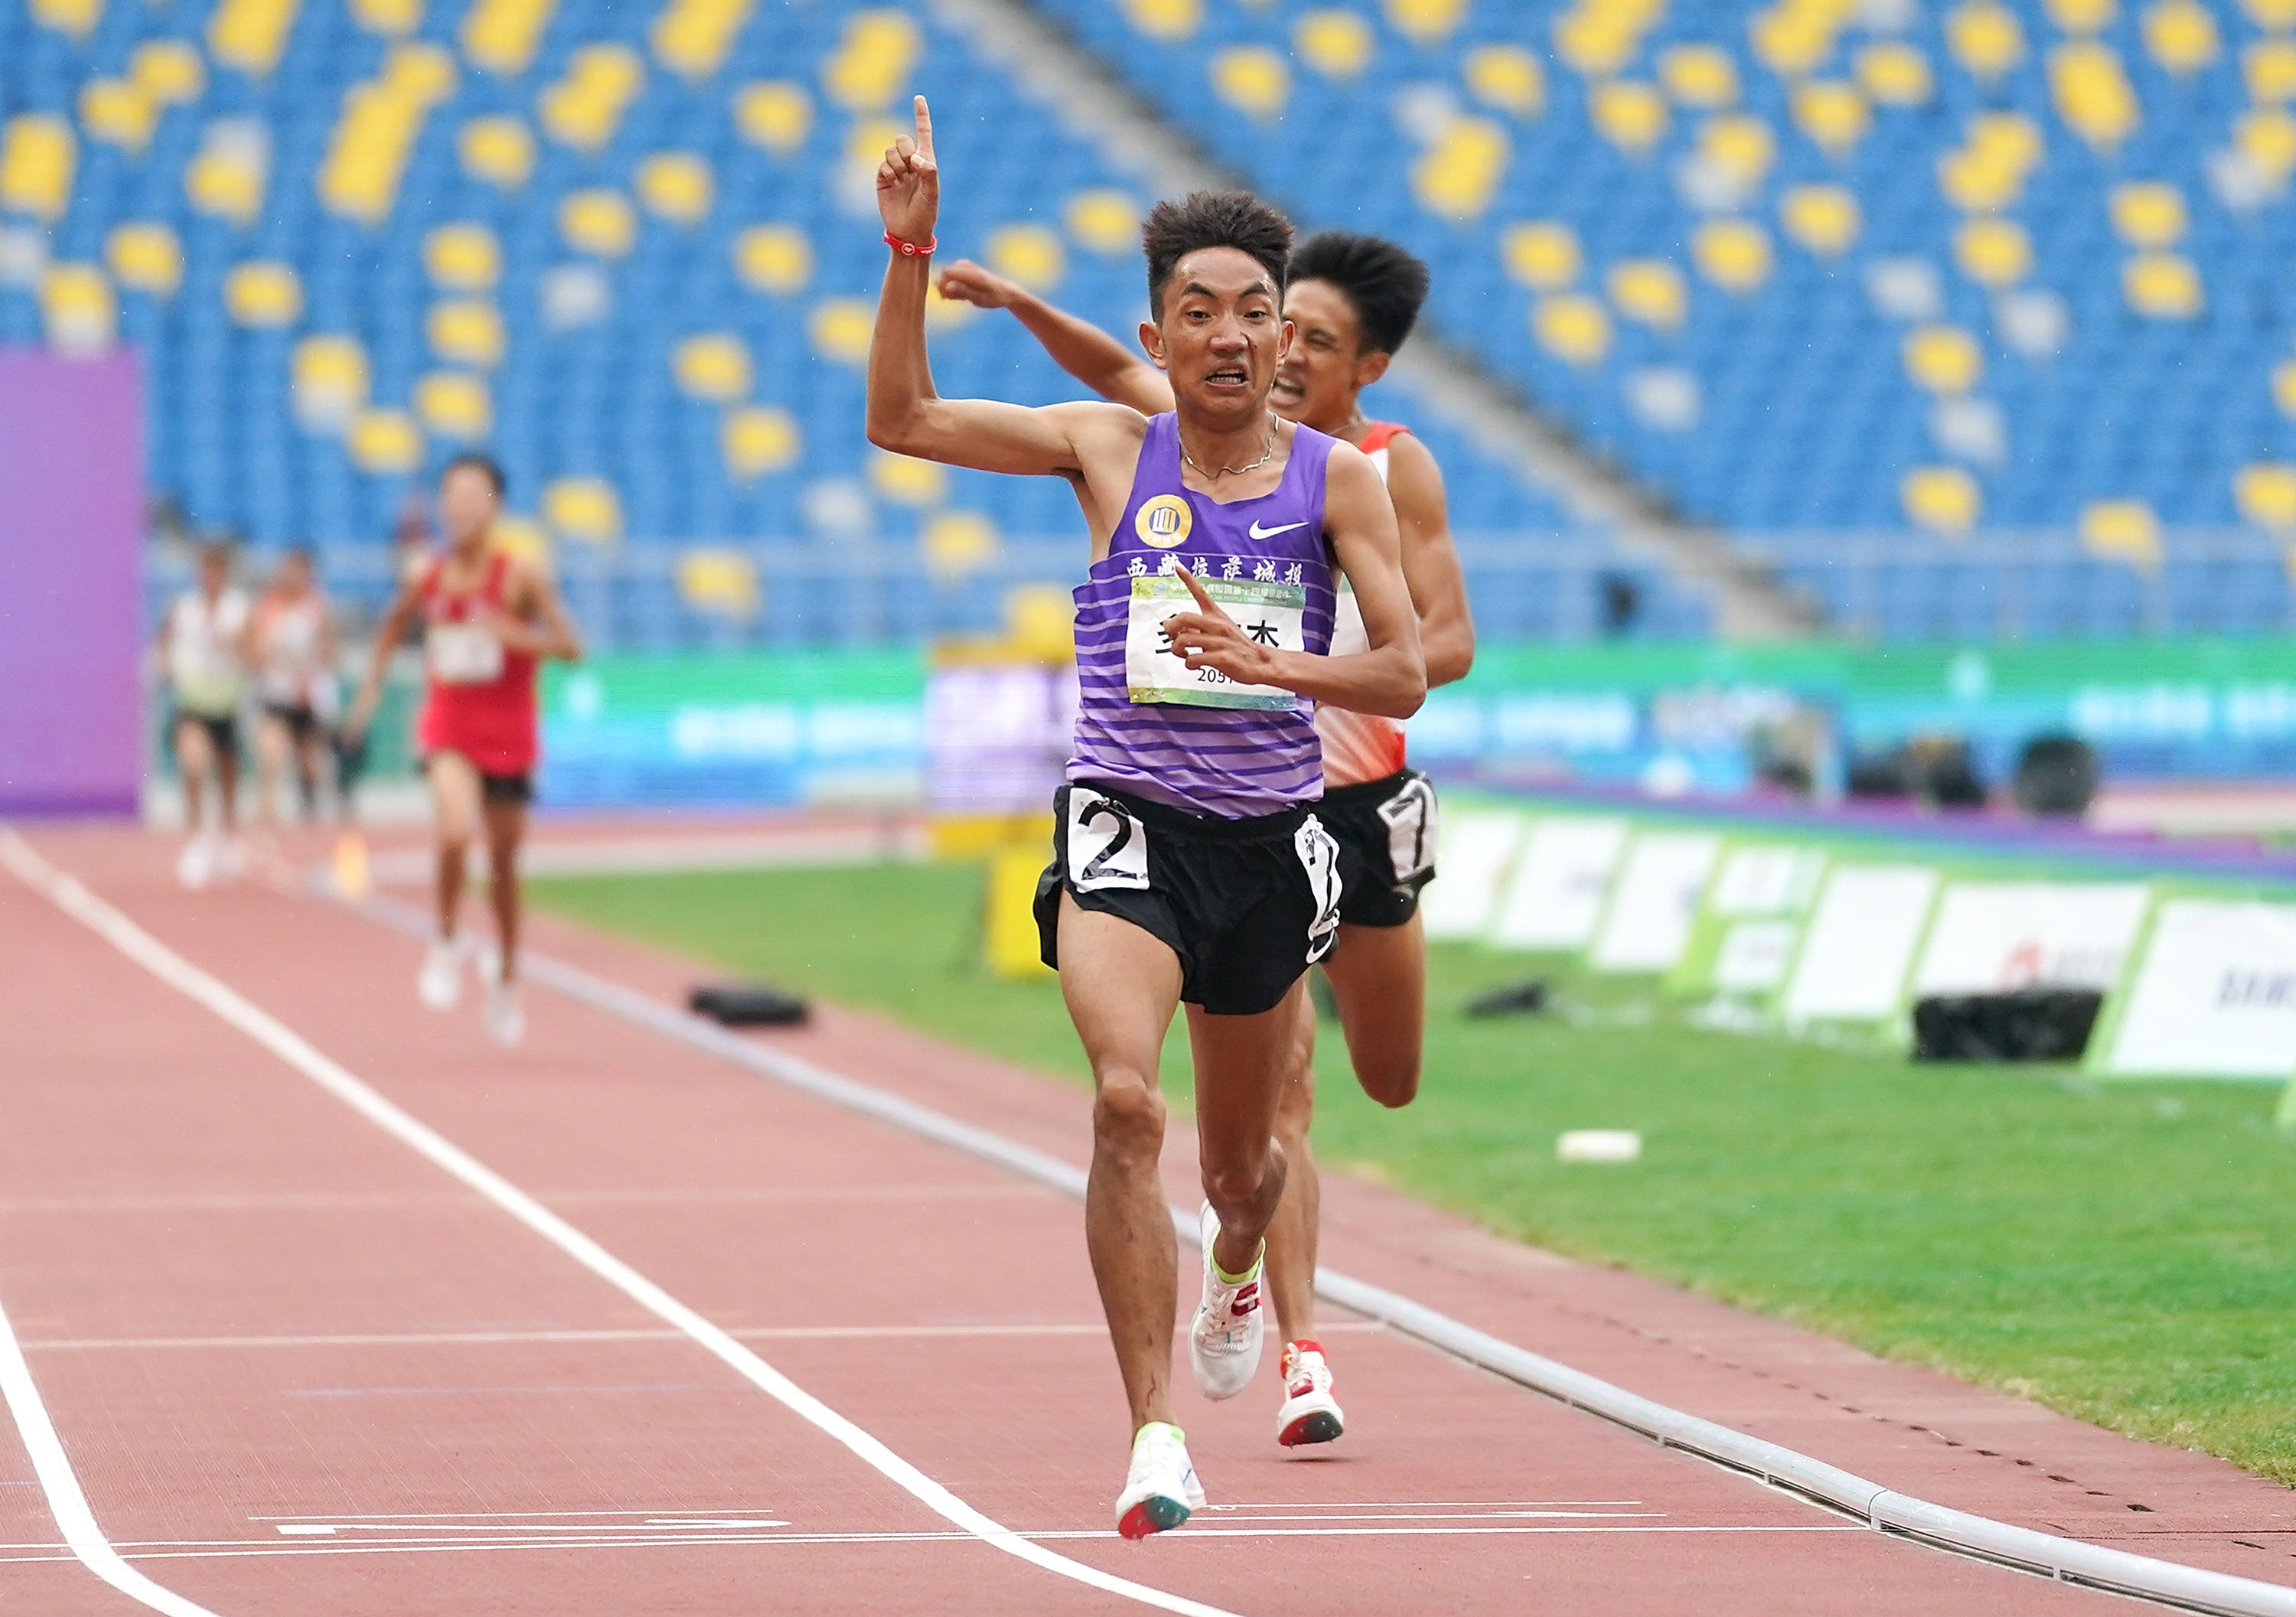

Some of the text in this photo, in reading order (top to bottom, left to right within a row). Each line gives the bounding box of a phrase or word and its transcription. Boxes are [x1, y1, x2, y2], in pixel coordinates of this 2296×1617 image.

[1127, 553, 1303, 587] 西藏拉萨城投
[1197, 668, 1233, 684] 205
[1078, 800, 1138, 881] 2
[1386, 785, 1427, 870] 7
